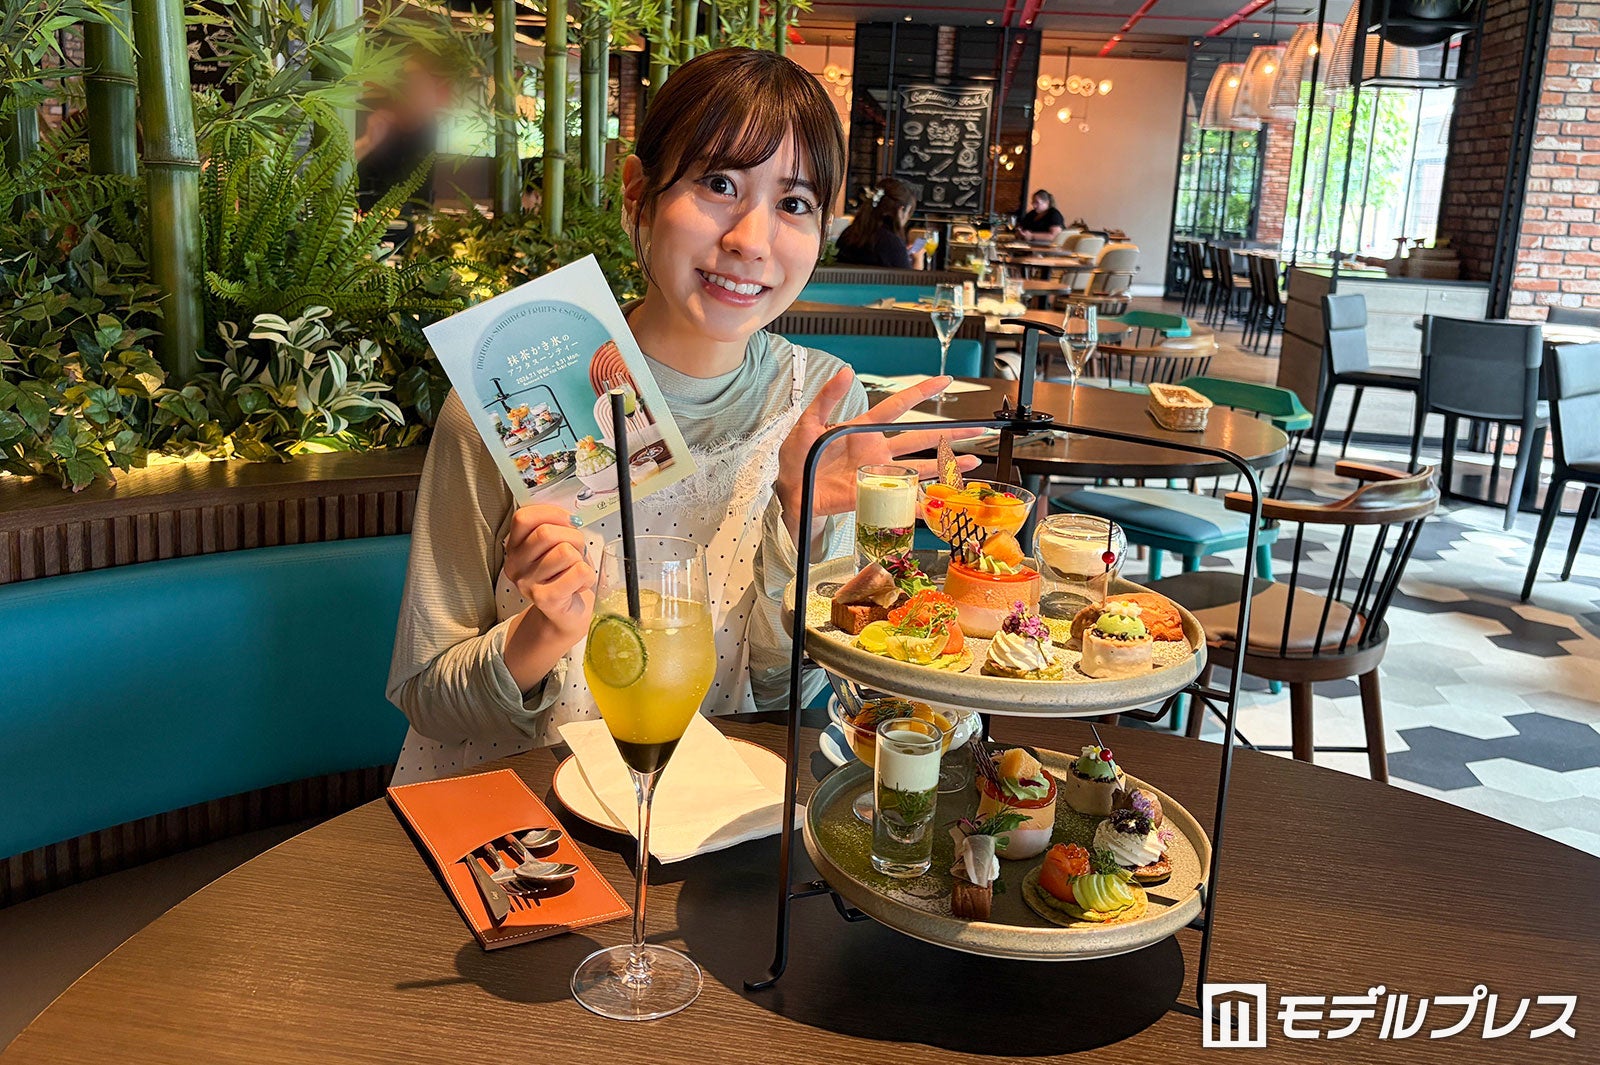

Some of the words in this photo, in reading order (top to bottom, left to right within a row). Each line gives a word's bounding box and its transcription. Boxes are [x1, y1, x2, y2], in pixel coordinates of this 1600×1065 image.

[506, 334, 570, 367] 抹茶かき氷の
